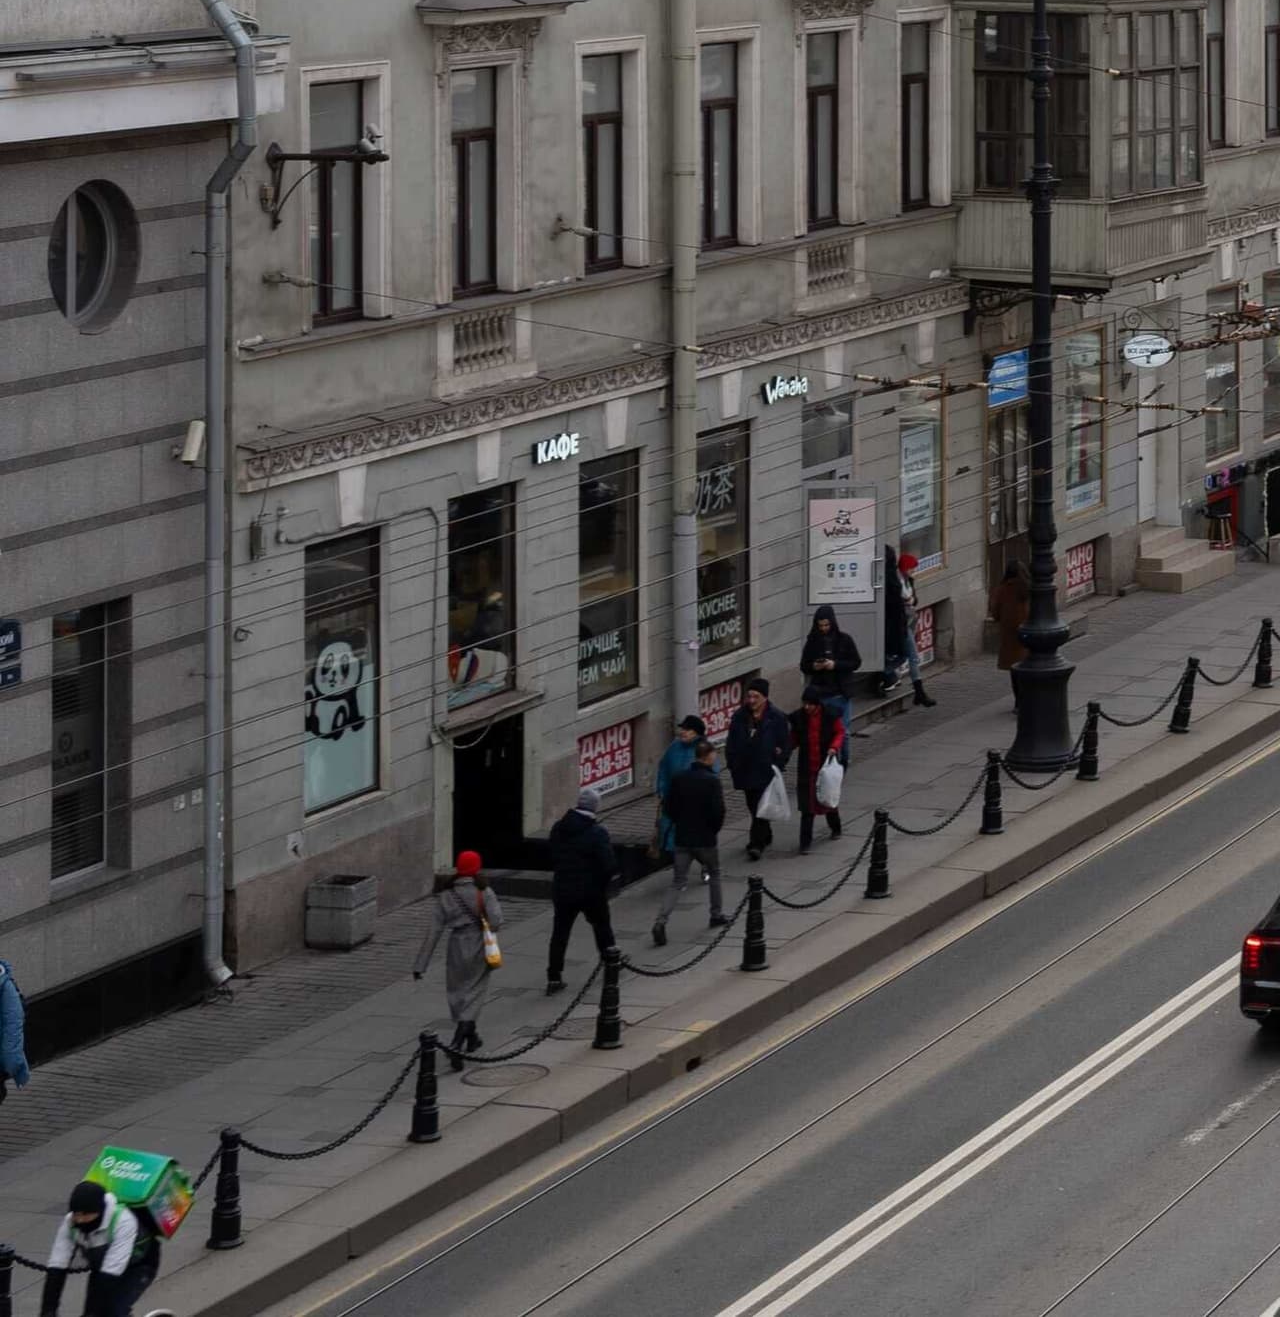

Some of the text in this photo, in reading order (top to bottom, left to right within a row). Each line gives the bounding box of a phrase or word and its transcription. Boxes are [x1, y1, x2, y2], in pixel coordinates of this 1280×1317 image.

[537, 433, 579, 464] КАФЕ
[698, 593, 738, 620] КУСНЕЕ,
[712, 615, 742, 641] КОФЕ
[602, 654, 627, 678] ЧАЙ
